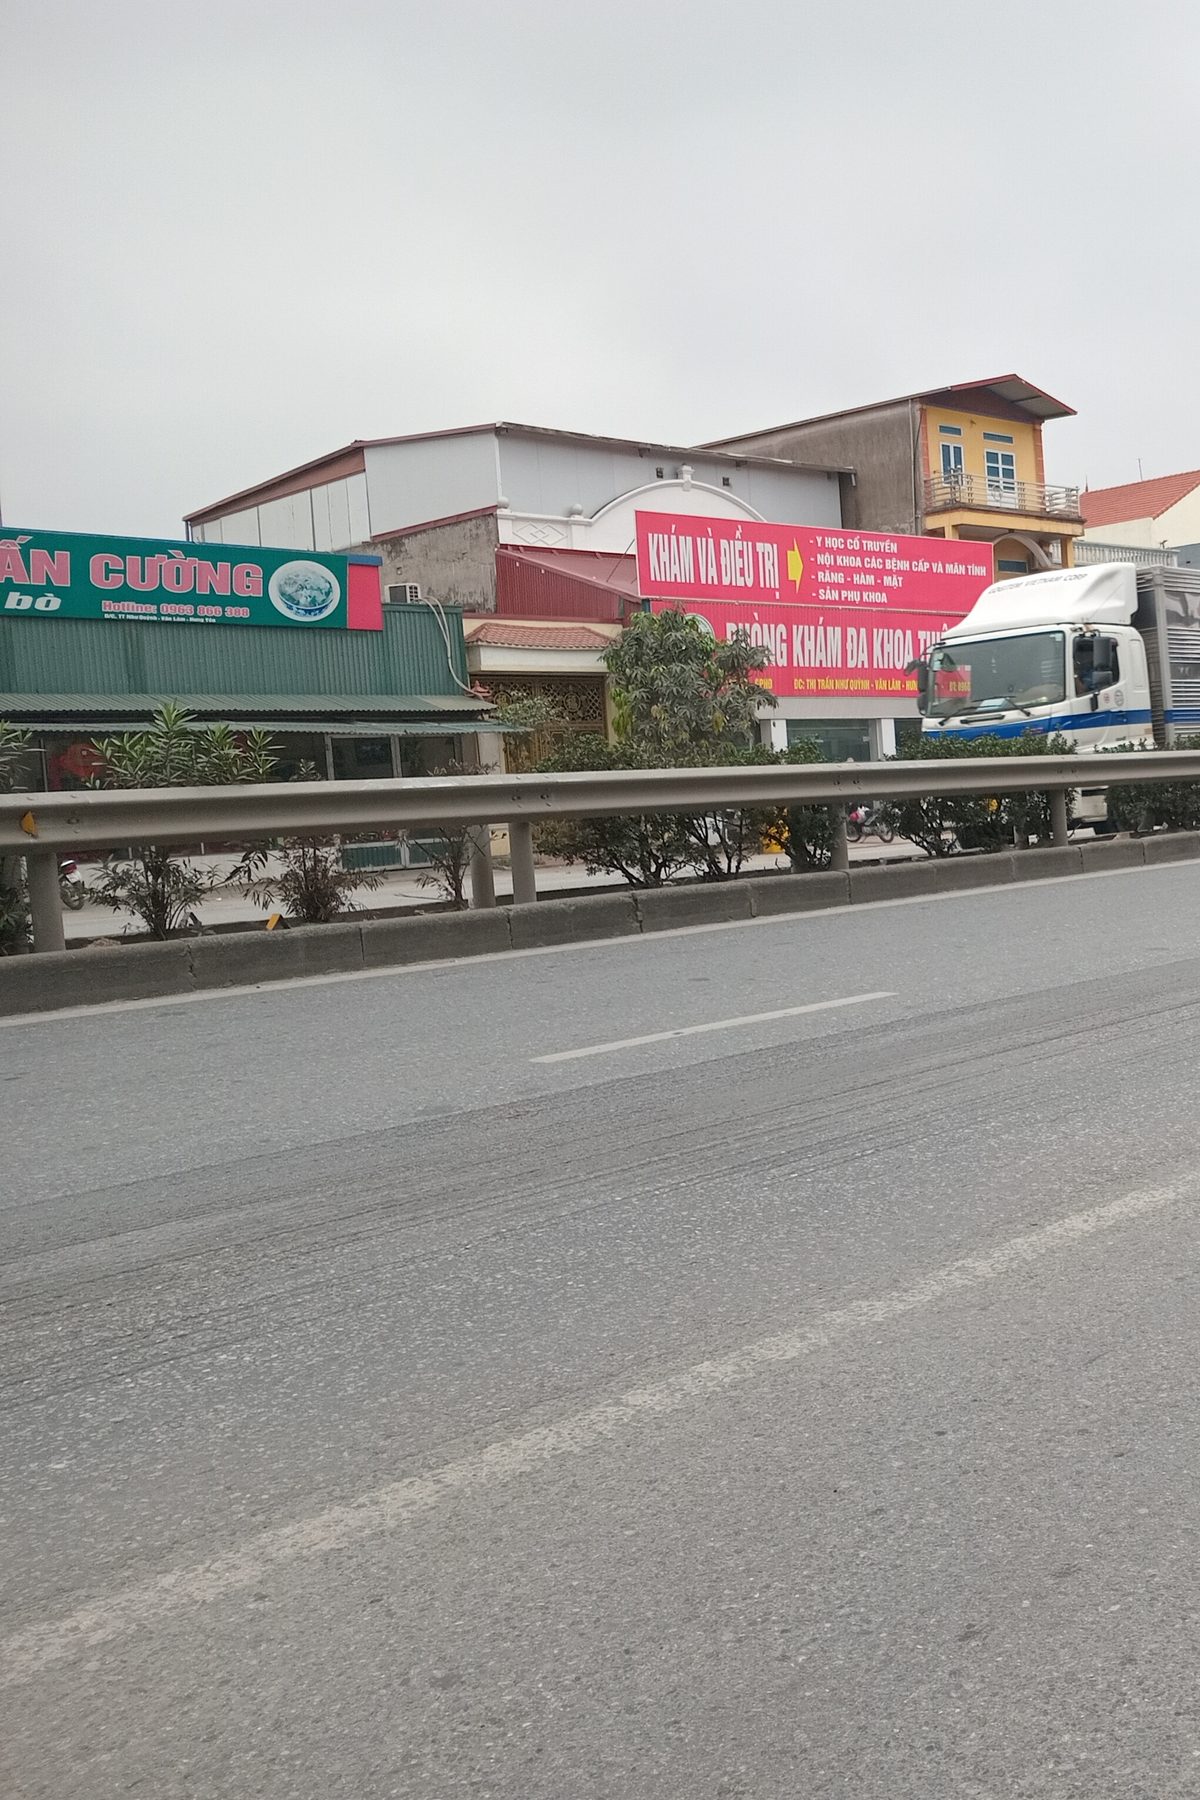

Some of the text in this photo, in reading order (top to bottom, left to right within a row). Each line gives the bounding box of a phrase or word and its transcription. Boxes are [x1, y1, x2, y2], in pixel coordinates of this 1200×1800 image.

[816, 536, 822, 547] Y
[825, 536, 844, 551] HỌC
[648, 524, 780, 600] KHÁM VÀ ĐIỀU TRỊ
[817, 552, 834, 568] NỘI
[836, 555, 862, 568] KHOA
[864, 556, 883, 569] CÁC
[885, 557, 910, 572] BỆNH
[912, 558, 930, 572] CẤP
[931, 561, 944, 574] VÀ
[967, 563, 986, 576] TÍNH
[89, 550, 263, 597] CƯỜNG
[817, 570, 845, 584] RĂNG
[853, 572, 875, 586] HÀM
[883, 574, 903, 589] MẶT
[4, 591, 61, 611] bò
[818, 585, 839, 601] SẢN
[841, 590, 860, 604] PHỤ
[863, 591, 888, 603] KHOA
[102, 600, 157, 614] Hotline:
[159, 603, 194, 616] 0963
[792, 616, 842, 668] KHÁM
[846, 627, 869, 669] ĐA
[872, 628, 914, 669] KHOA
